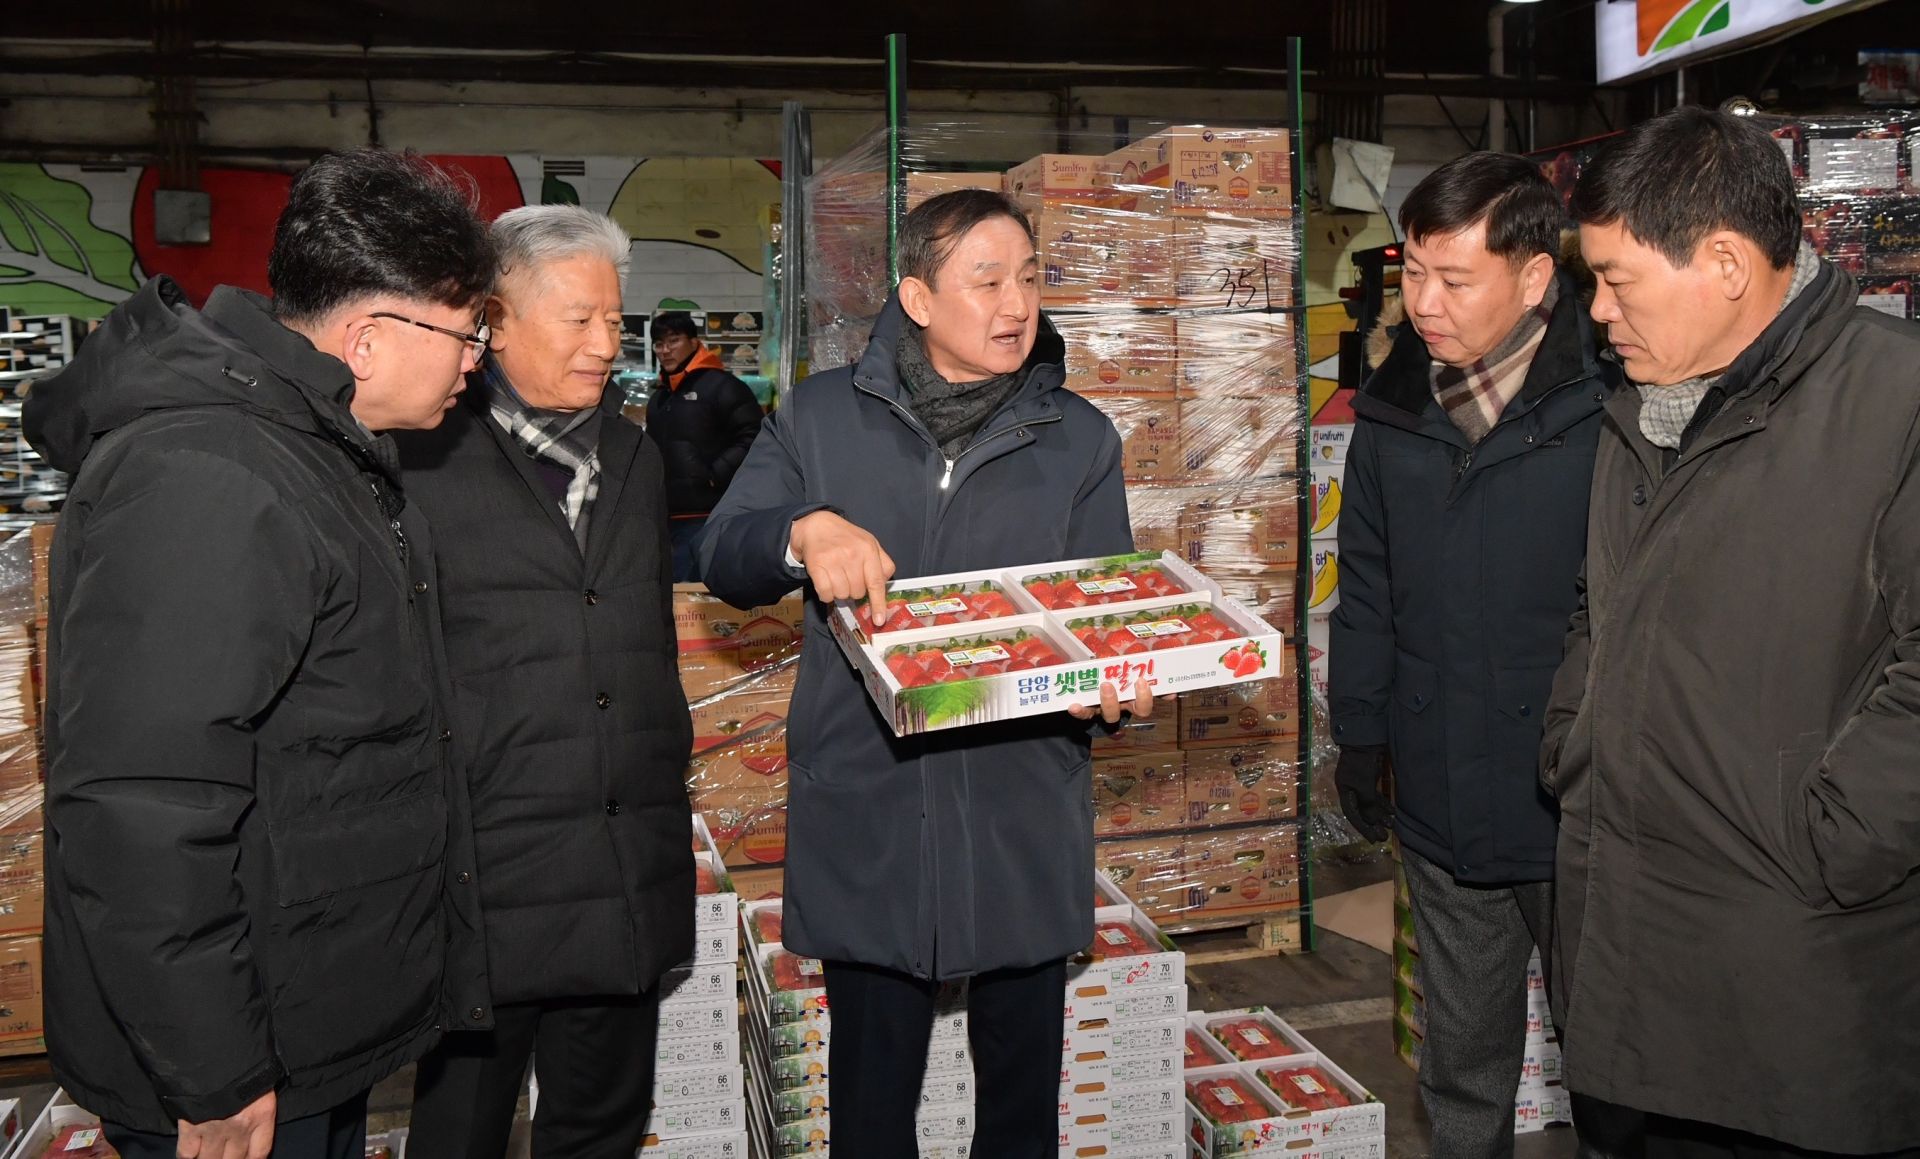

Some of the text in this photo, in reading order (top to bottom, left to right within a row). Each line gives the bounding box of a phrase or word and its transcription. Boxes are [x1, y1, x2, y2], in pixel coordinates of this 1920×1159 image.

[1052, 161, 1087, 173] Sumifru
[1319, 431, 1345, 442] unifrutti
[675, 608, 706, 621] mifru
[1018, 674, 1050, 694] 담양
[1054, 666, 1099, 697] 샛별
[1103, 658, 1155, 693] 딸기
[1019, 693, 1050, 707] 늘푸름
[743, 731, 784, 744] Sumifr
[712, 903, 722, 913] 66
[712, 939, 722, 949] 66
[1161, 963, 1170, 973] 70
[710, 974, 721, 984] 66
[1164, 995, 1174, 1005] 70
[712, 1009, 722, 1019] 66
[953, 1018, 963, 1028] 68
[1162, 1028, 1171, 1038] 70
[713, 1041, 723, 1051] 66
[955, 1050, 965, 1060] 68
[1161, 1058, 1170, 1068] 70
[717, 1074, 728, 1084] 66
[956, 1082, 966, 1092] 68
[1161, 1091, 1171, 1101] 70
[720, 1107, 730, 1117] 66
[956, 1117, 966, 1126] 68
[1369, 1114, 1377, 1123] 77
[1161, 1122, 1170, 1131] 70
[722, 1142, 733, 1152] 66
[957, 1146, 967, 1155] 68
[1369, 1143, 1378, 1152] 77
